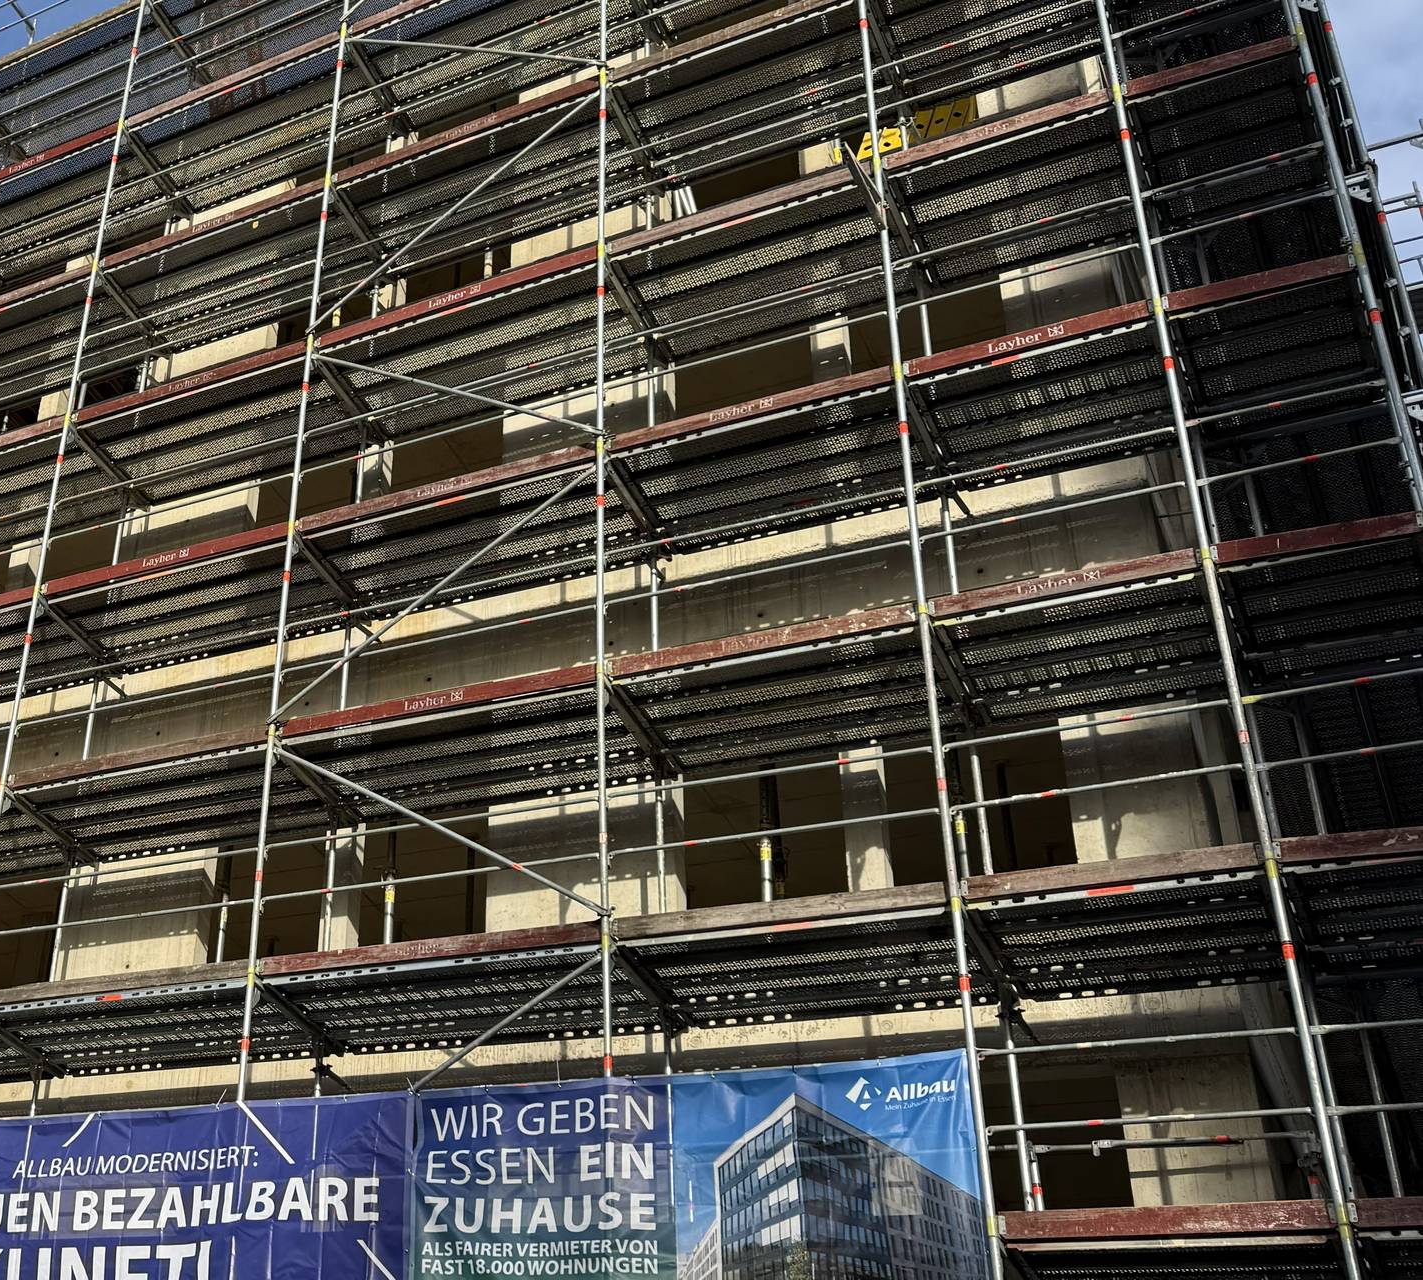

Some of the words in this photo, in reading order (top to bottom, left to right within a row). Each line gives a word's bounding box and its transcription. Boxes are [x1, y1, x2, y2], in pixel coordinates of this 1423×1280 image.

[8, 158, 34, 174] Layher
[193, 216, 221, 233] Layher
[428, 290, 467, 309] Layher
[988, 332, 1042, 354] Layher
[168, 376, 201, 392] Layher
[709, 403, 755, 422] Layher
[417, 480, 456, 498] Layher
[142, 552, 177, 568] Layher
[403, 694, 446, 711] Layher
[885, 1079, 956, 1103] Allbau
[431, 1102, 503, 1141] WIR
[517, 1094, 654, 1136] GEBEN
[12, 1156, 91, 1179] ALLBAU
[94, 1145, 259, 1175] MODERNISIERT:
[426, 1147, 554, 1185] ESSEN
[580, 1142, 654, 1181] EIN
[72, 1176, 380, 1232] BEZAHLBARE
[424, 1192, 657, 1233] ZUHAUSE
[421, 1241, 453, 1257] ALS
[455, 1241, 513, 1257] FAIRER
[516, 1240, 612, 1258] VERMIETER
[615, 1239, 658, 1255] VON
[421, 1258, 465, 1275] FAST
[467, 1259, 524, 1276] 18.000
[527, 1256, 658, 1276] WOHNUNGEN
